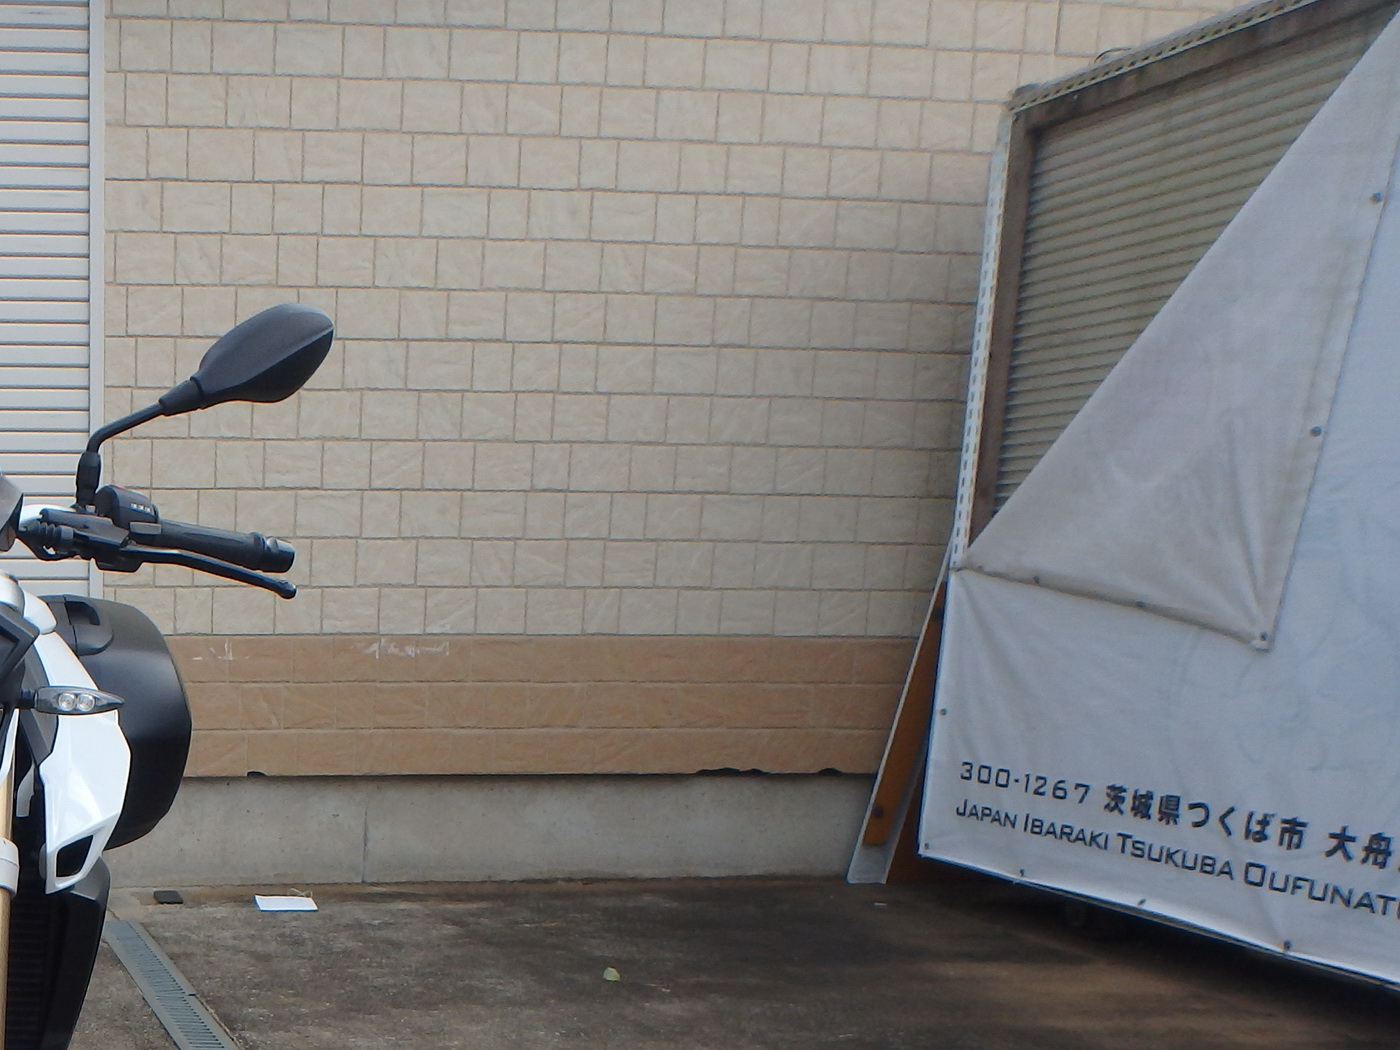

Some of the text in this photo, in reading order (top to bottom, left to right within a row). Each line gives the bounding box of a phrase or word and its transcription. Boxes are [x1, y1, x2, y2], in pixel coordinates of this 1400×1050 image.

[961, 762, 1400, 870] 300-1267 茨城県つくば市 大舟
[1244, 861, 1400, 920] OUFUNAT
